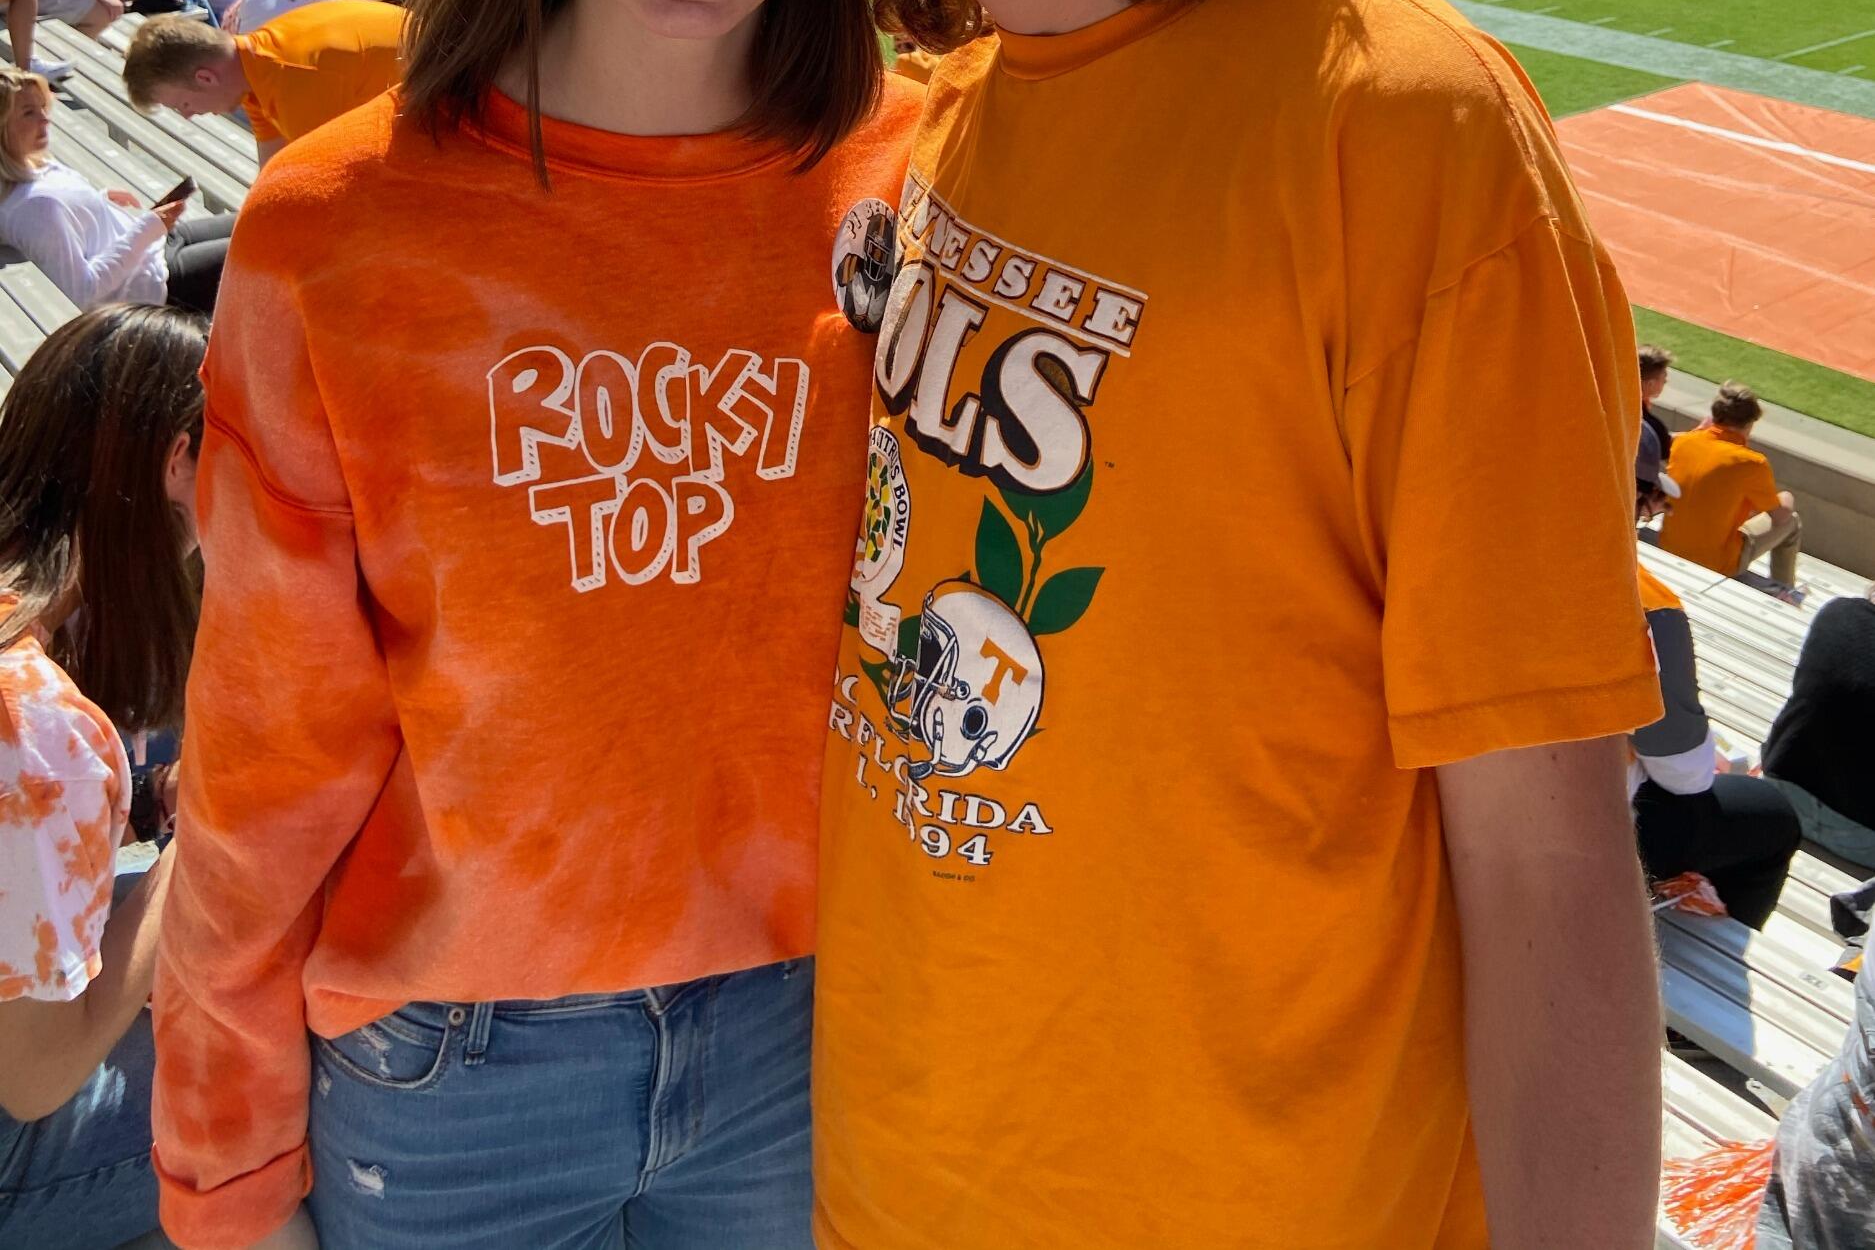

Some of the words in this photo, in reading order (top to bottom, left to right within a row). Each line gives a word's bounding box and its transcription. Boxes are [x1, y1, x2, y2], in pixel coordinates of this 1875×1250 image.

[487, 341, 811, 487] ROCKY
[528, 472, 735, 594] TOP
[892, 483, 909, 551] BOWL
